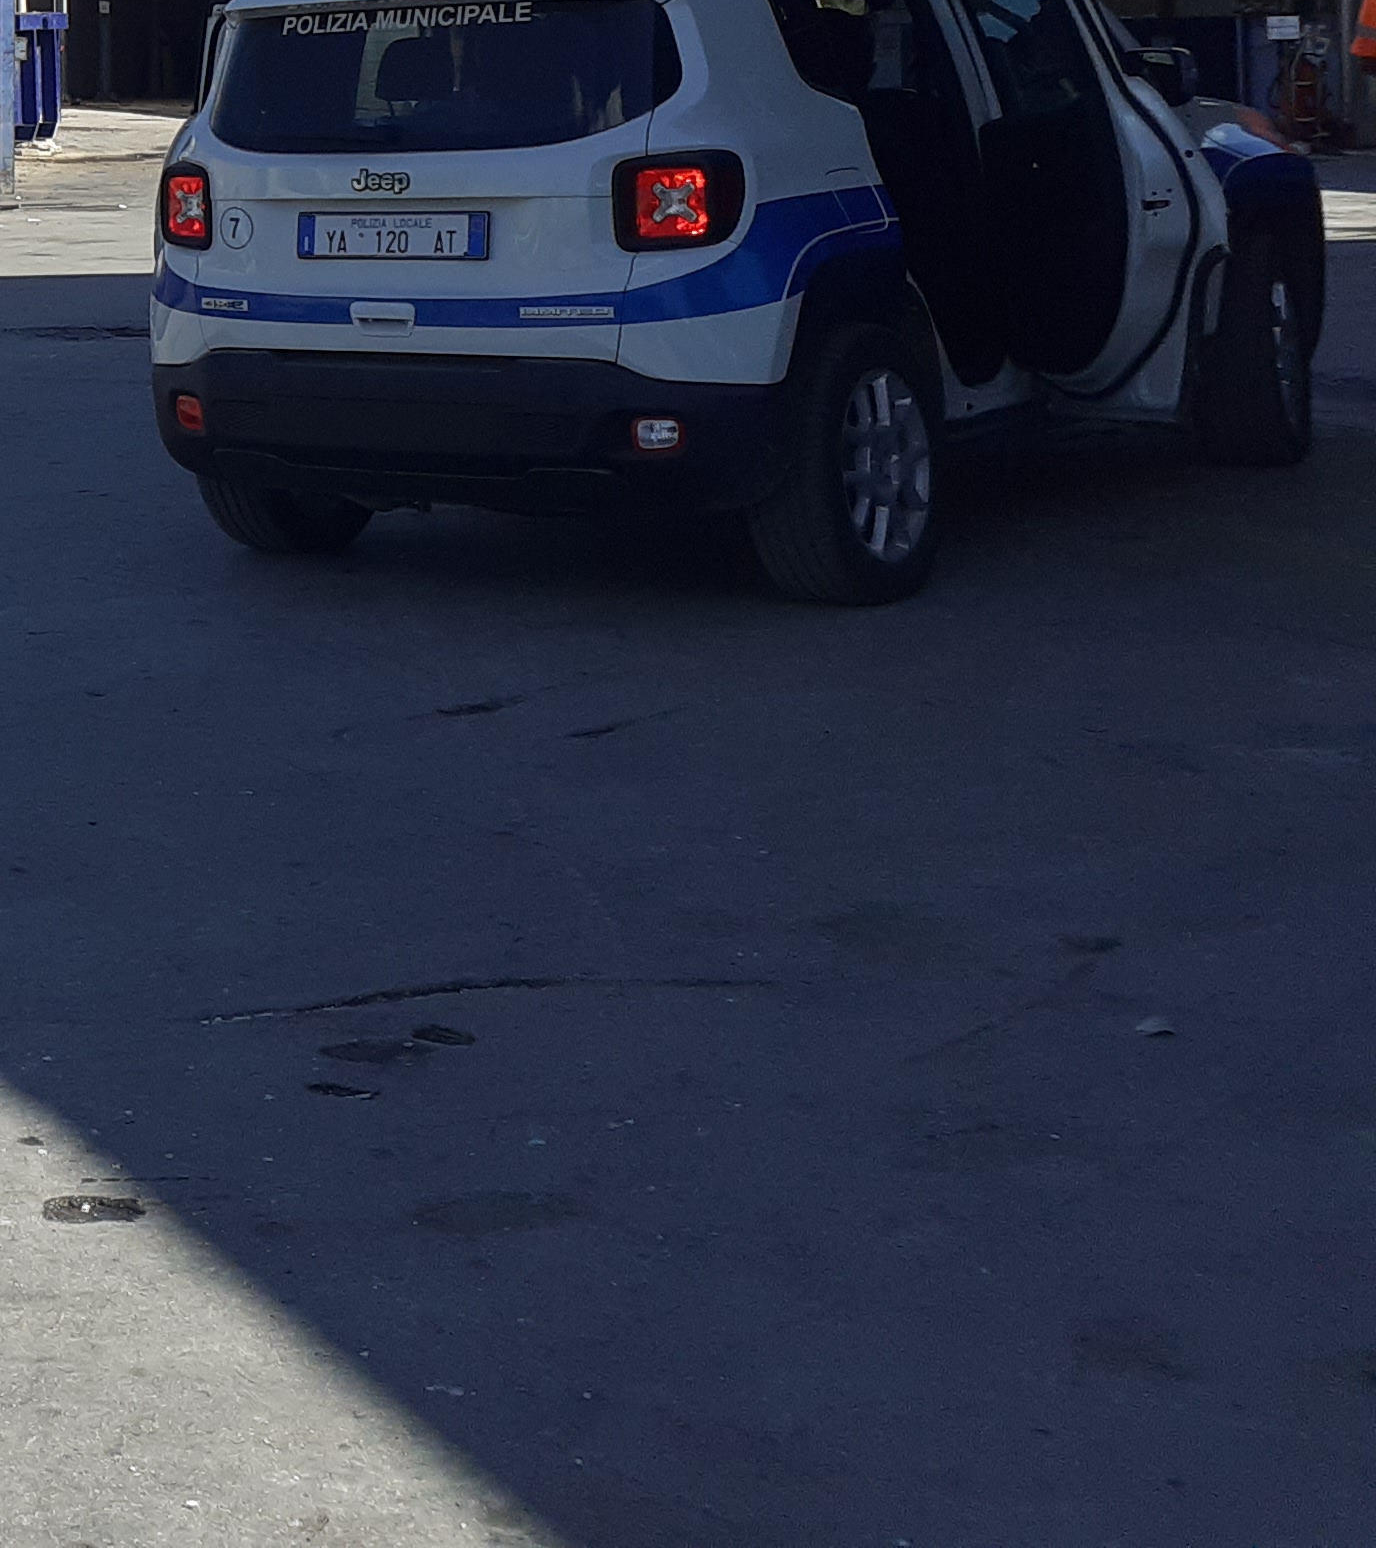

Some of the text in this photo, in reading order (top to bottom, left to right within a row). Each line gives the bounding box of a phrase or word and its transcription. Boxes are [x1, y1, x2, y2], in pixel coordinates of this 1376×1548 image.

[282, 1, 533, 35] POLIZIA MUNICIPALE
[351, 168, 410, 195] Jeep
[228, 217, 240, 239] 7
[351, 217, 433, 229] POLIZIA LOCALE
[326, 230, 457, 254] YA 120 AT
